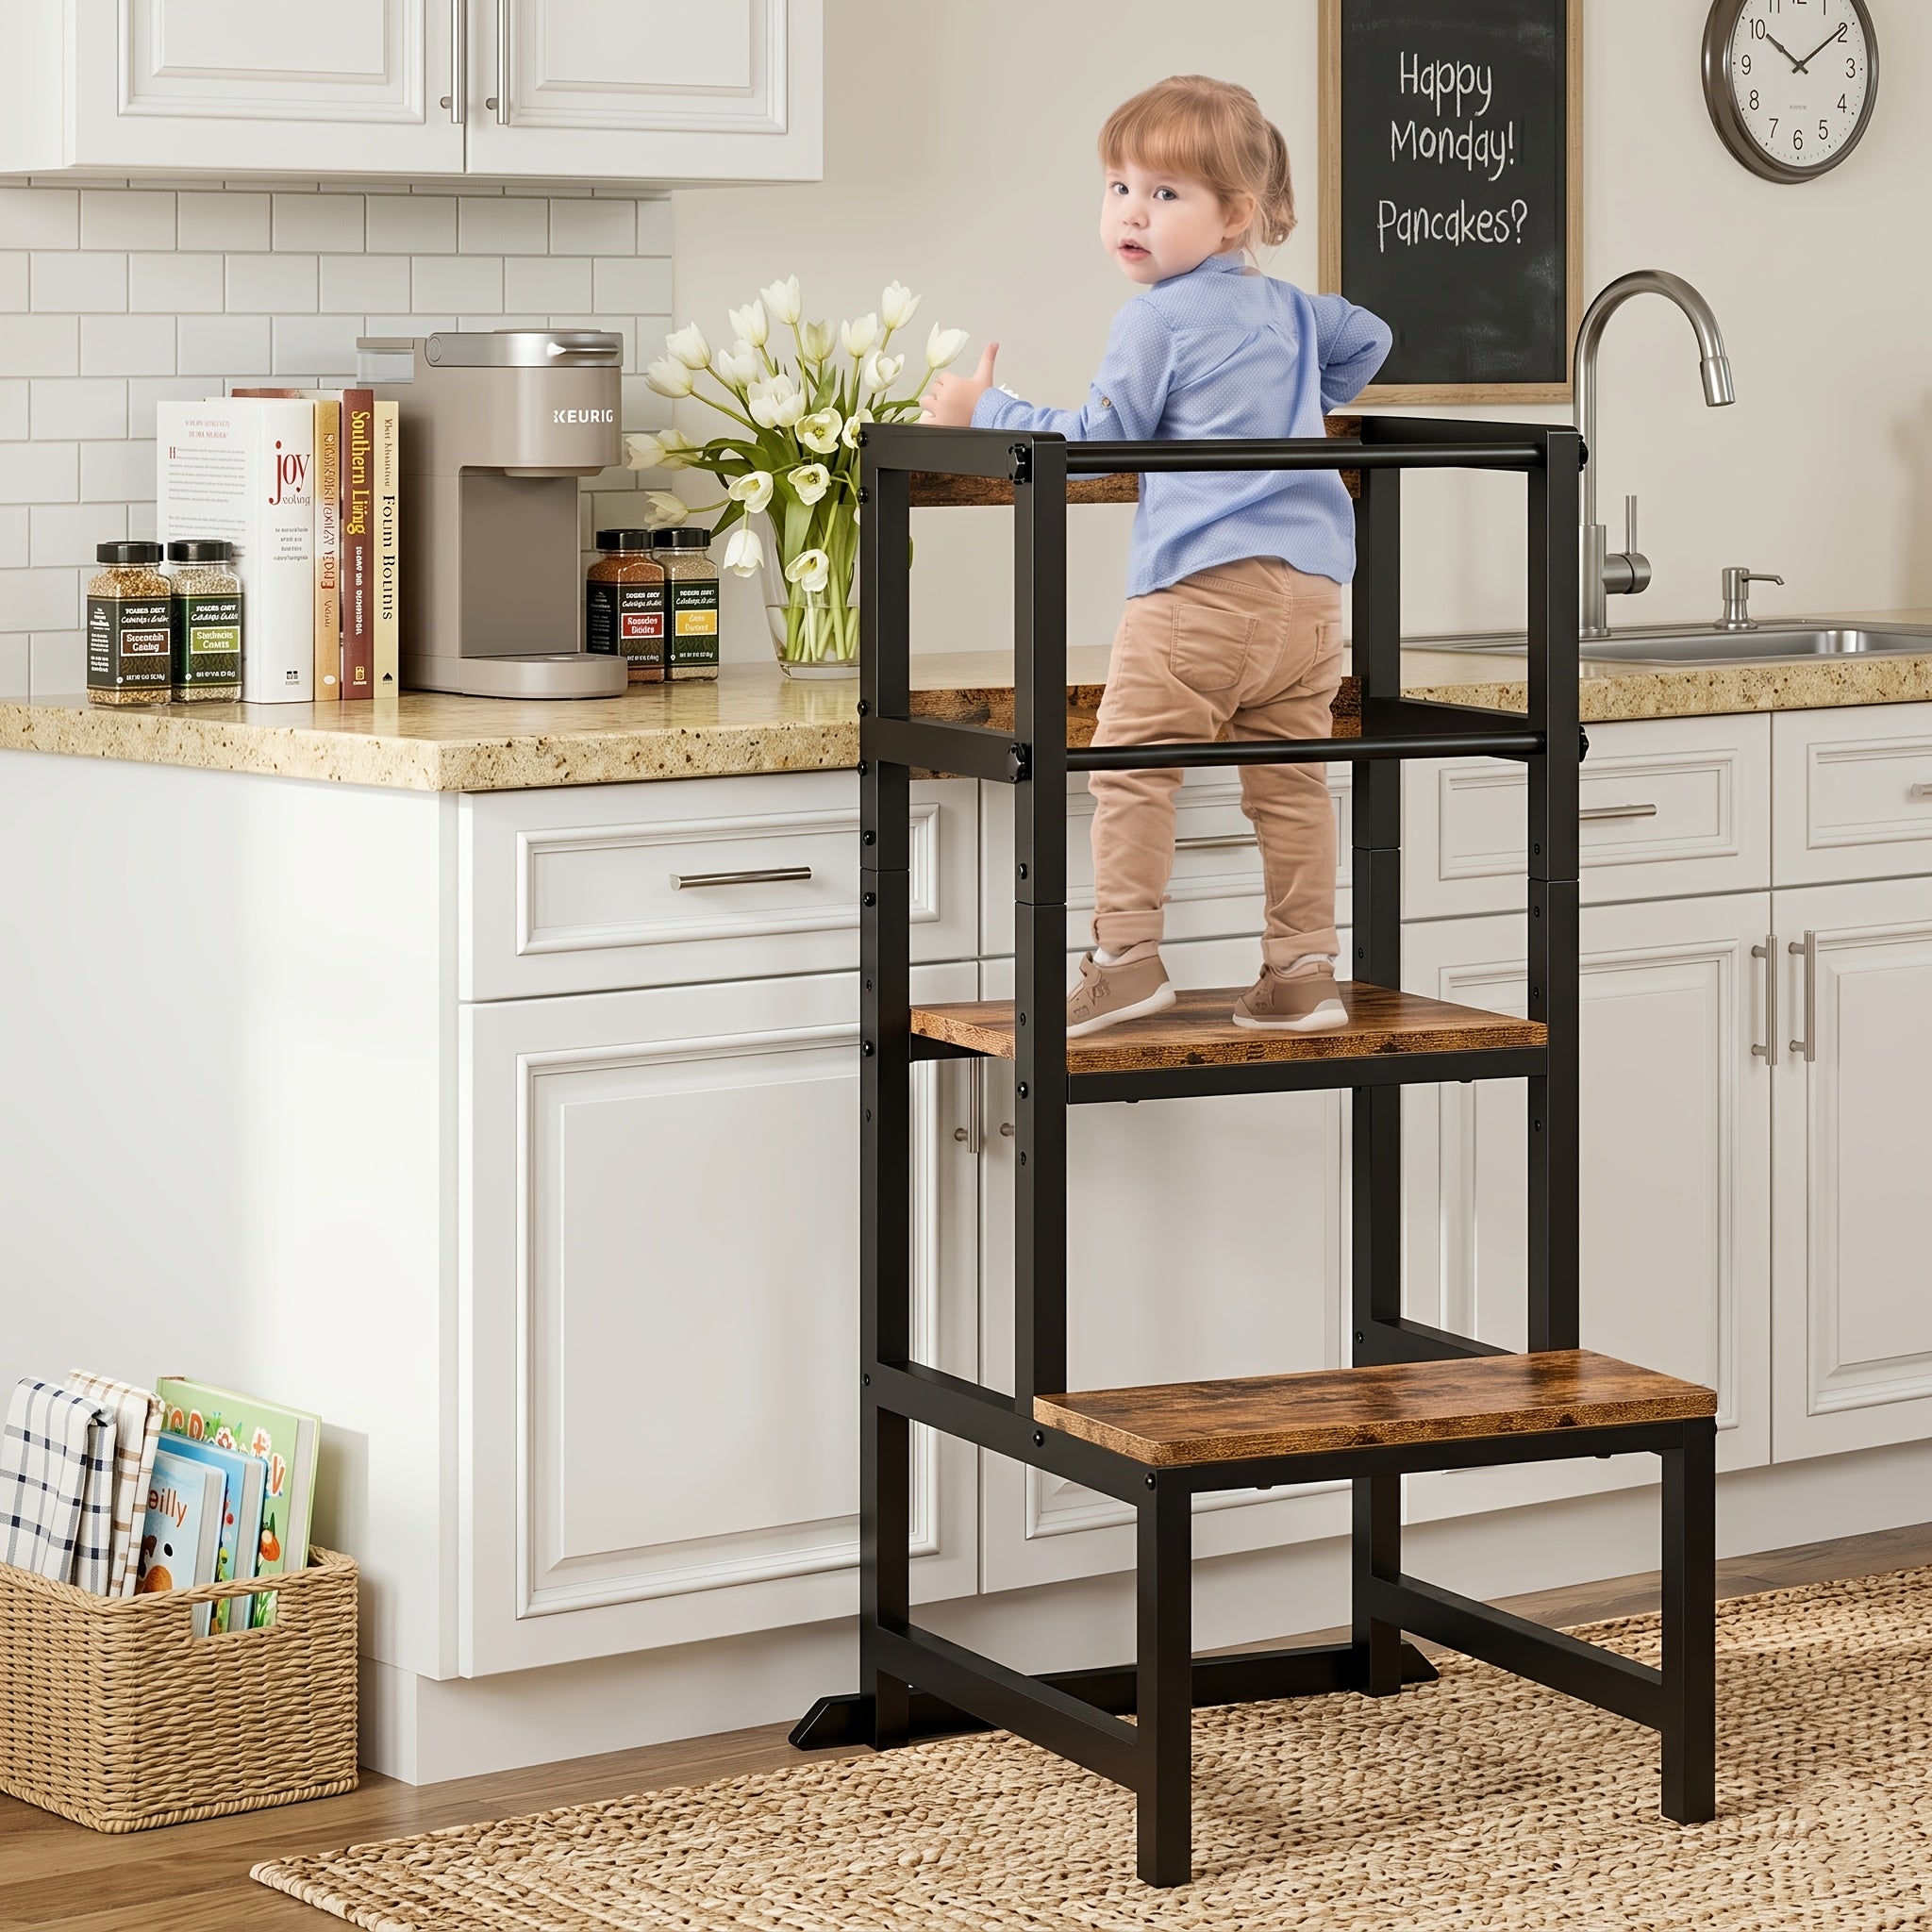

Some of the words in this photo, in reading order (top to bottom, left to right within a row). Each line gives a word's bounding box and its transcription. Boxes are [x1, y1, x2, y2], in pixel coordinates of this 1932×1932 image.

[1749, 19, 1766, 40] 10
[1838, 23, 1848, 42] 2
[1741, 55, 1751, 75] 9
[1845, 58, 1856, 78] 3
[1400, 51, 1492, 117] Happy
[1749, 90, 1759, 110] 8
[1837, 93, 1847, 113] 4
[1769, 119, 1779, 138] 7
[1818, 120, 1828, 140] 5
[1792, 130, 1803, 150] 6
[1391, 120, 1514, 181] Monday!
[1377, 199, 1528, 253] Pancakes?
[553, 409, 613, 424] KEURIG
[351, 410, 371, 485] Southern
[268, 440, 311, 506] joy
